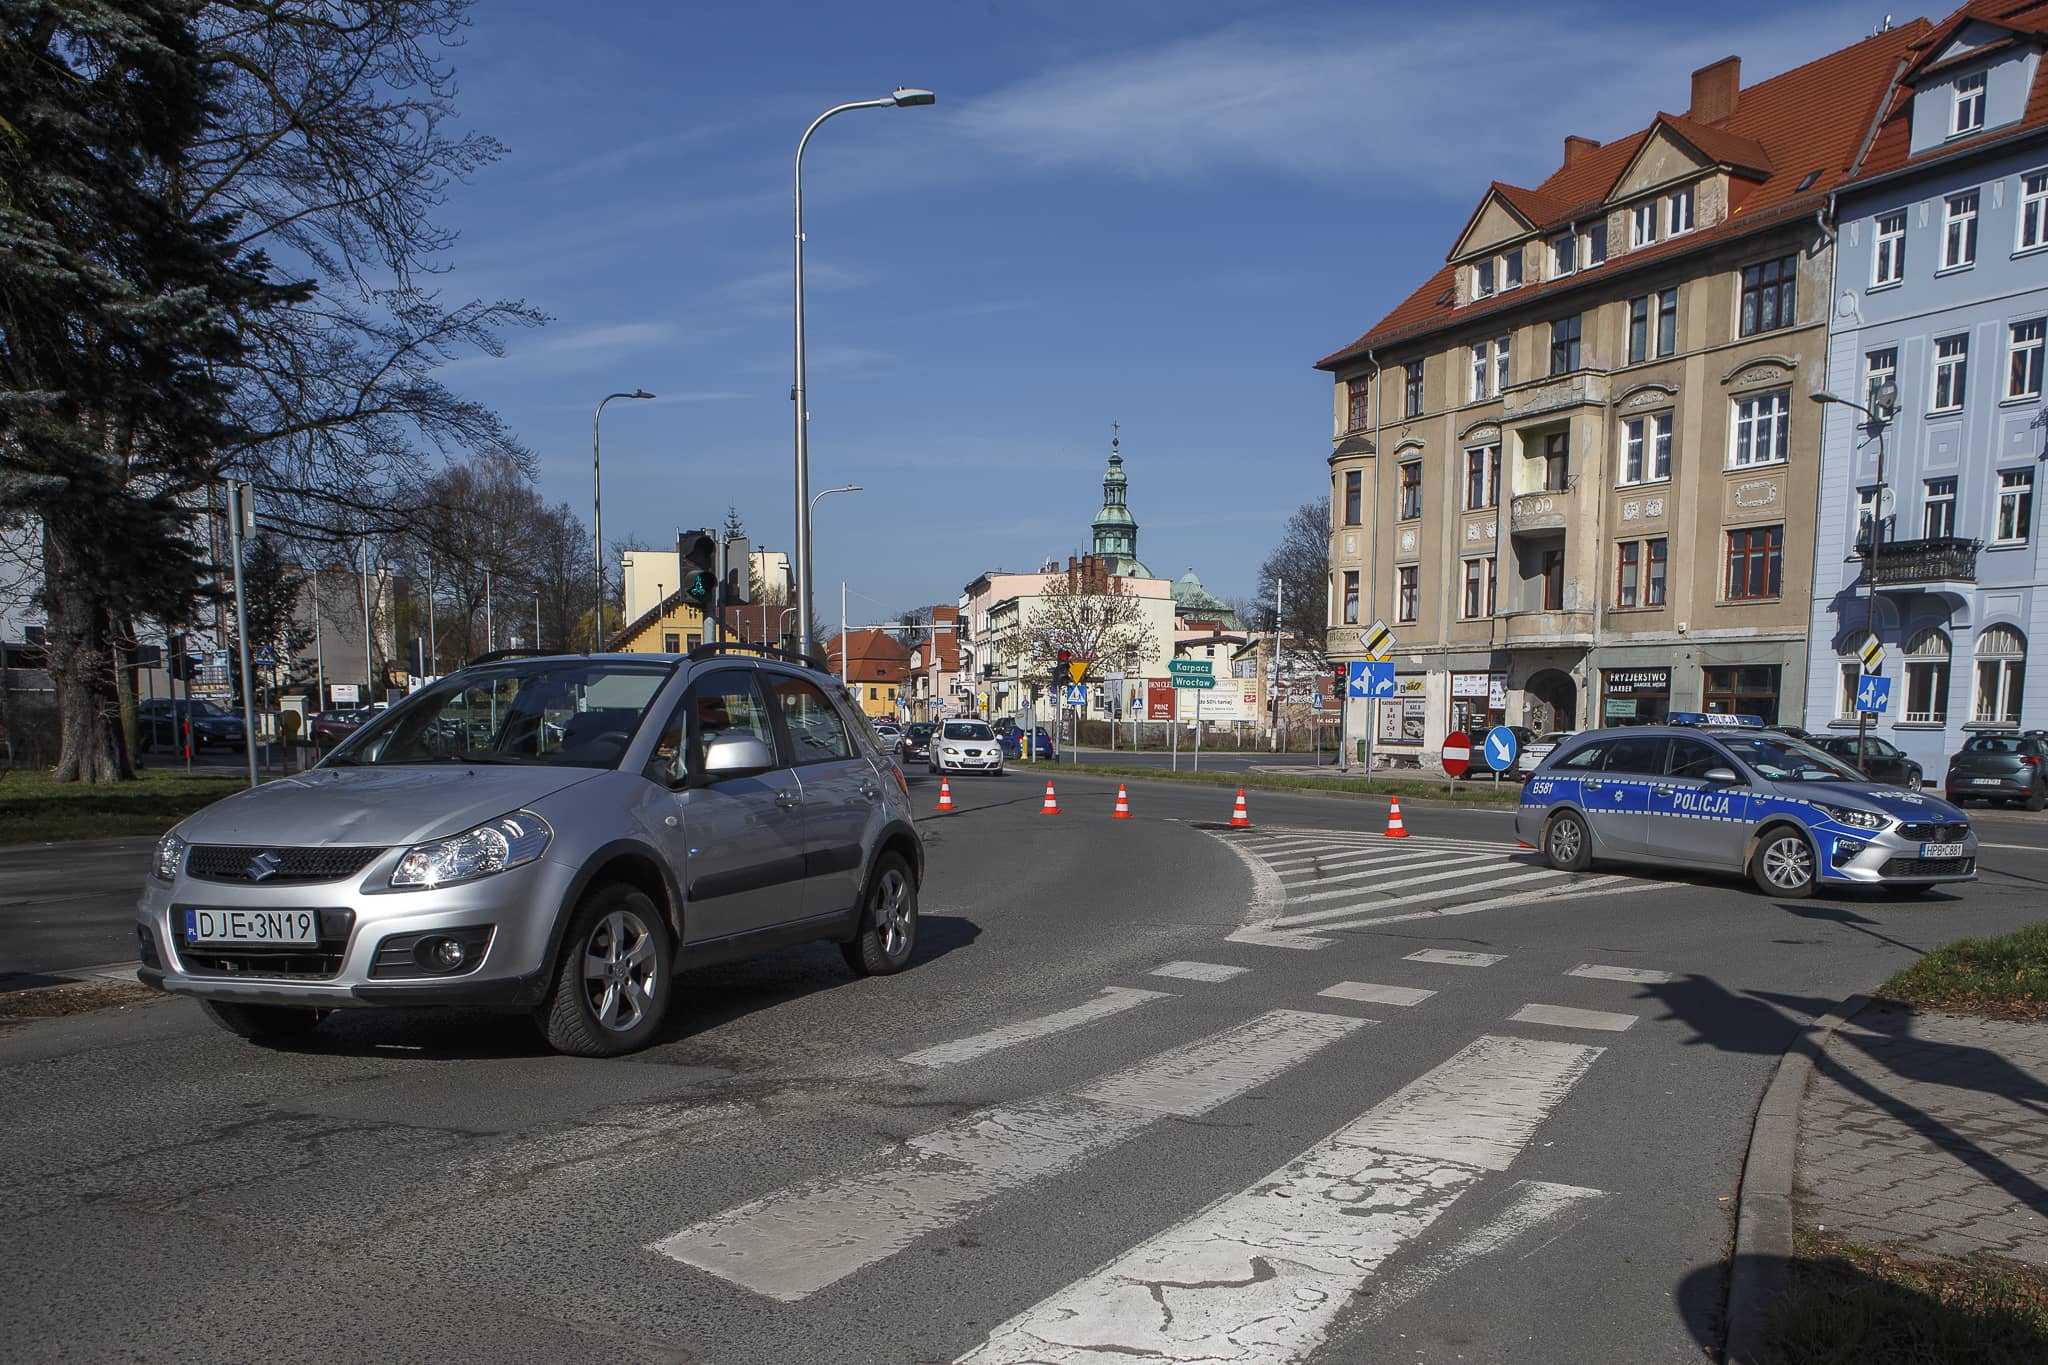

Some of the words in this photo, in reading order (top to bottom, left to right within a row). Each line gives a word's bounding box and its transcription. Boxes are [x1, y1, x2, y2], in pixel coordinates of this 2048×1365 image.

[1176, 663, 1209, 673] Karpacz
[1176, 677, 1211, 687] Wrocław
[1610, 672, 1667, 682] FRYZJERSTWO
[1610, 685, 1632, 693] BARBER
[1707, 714, 1738, 726] POLICJA
[1532, 782, 1553, 794] B581
[1673, 793, 1729, 815] POLICJA
[188, 927, 197, 936] PL
